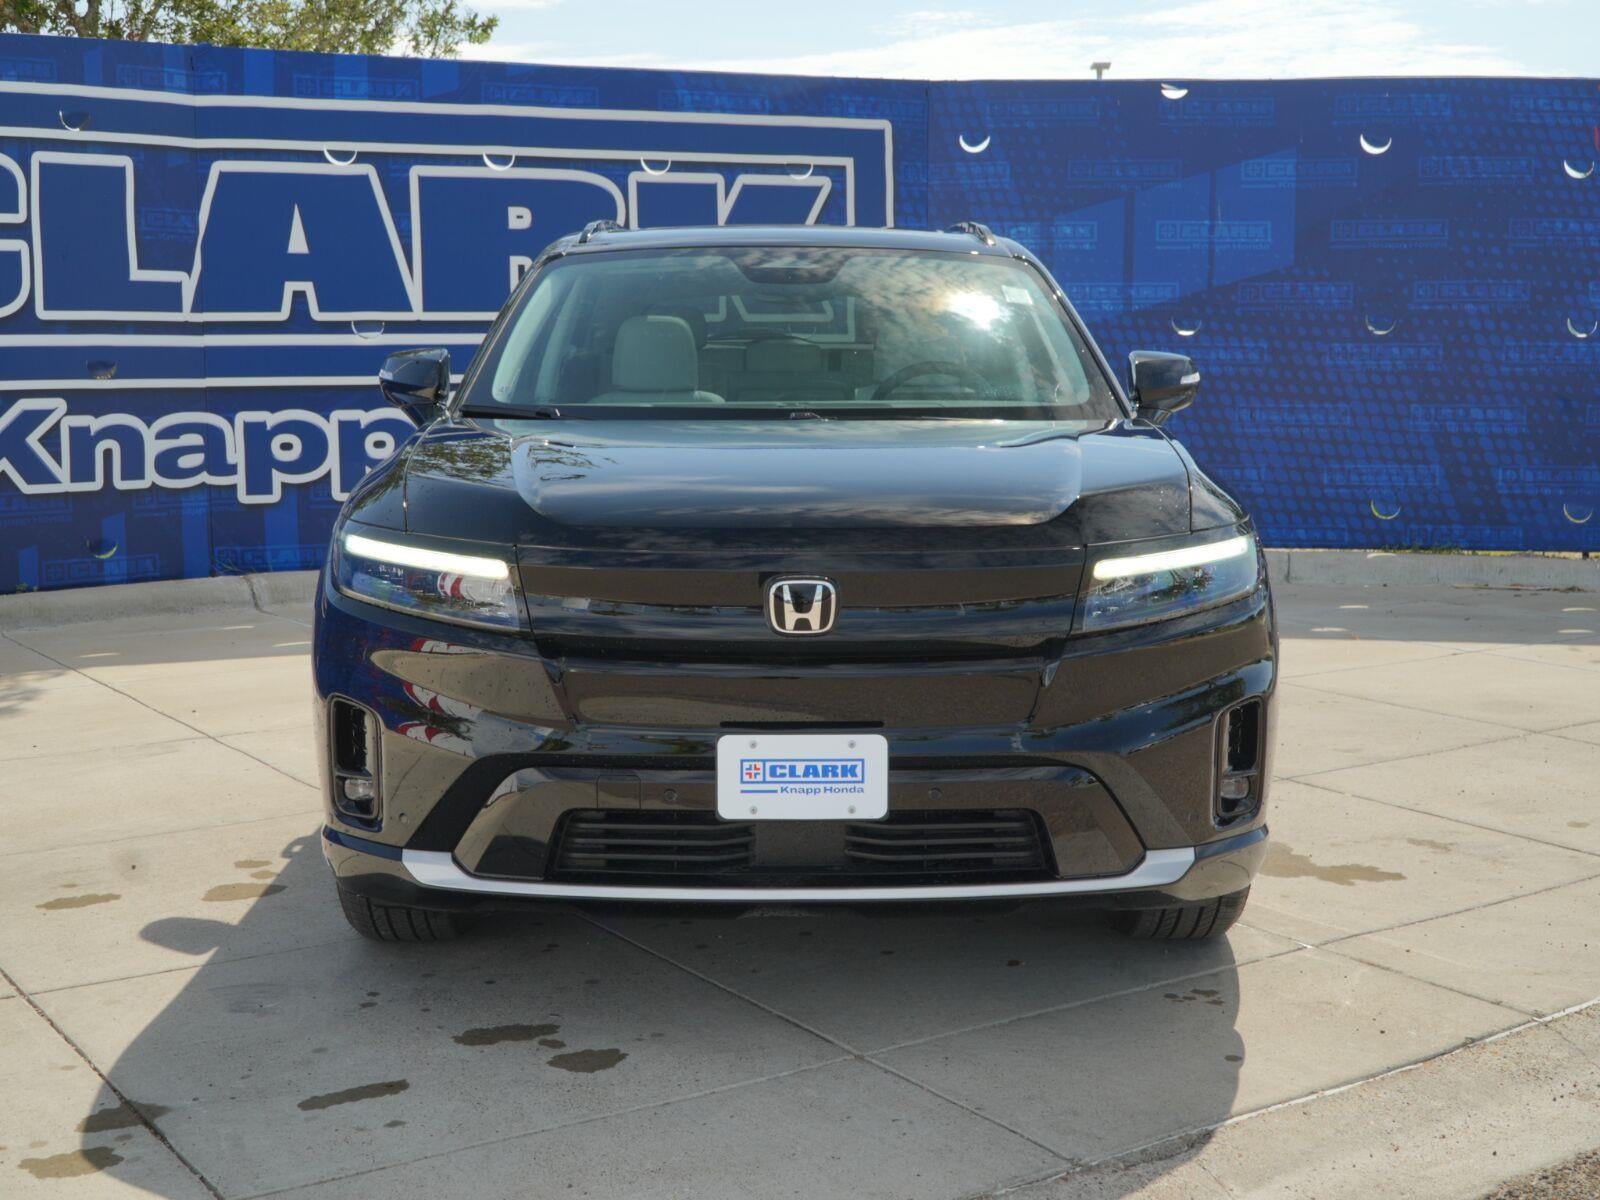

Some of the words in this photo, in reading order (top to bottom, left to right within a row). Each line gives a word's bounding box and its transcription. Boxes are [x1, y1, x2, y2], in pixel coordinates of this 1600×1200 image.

[0, 151, 833, 322] LARK
[0, 398, 415, 504] Knapp
[768, 764, 859, 779] CLARK
[780, 785, 822, 795] Knapp
[823, 785, 865, 794] Honda
